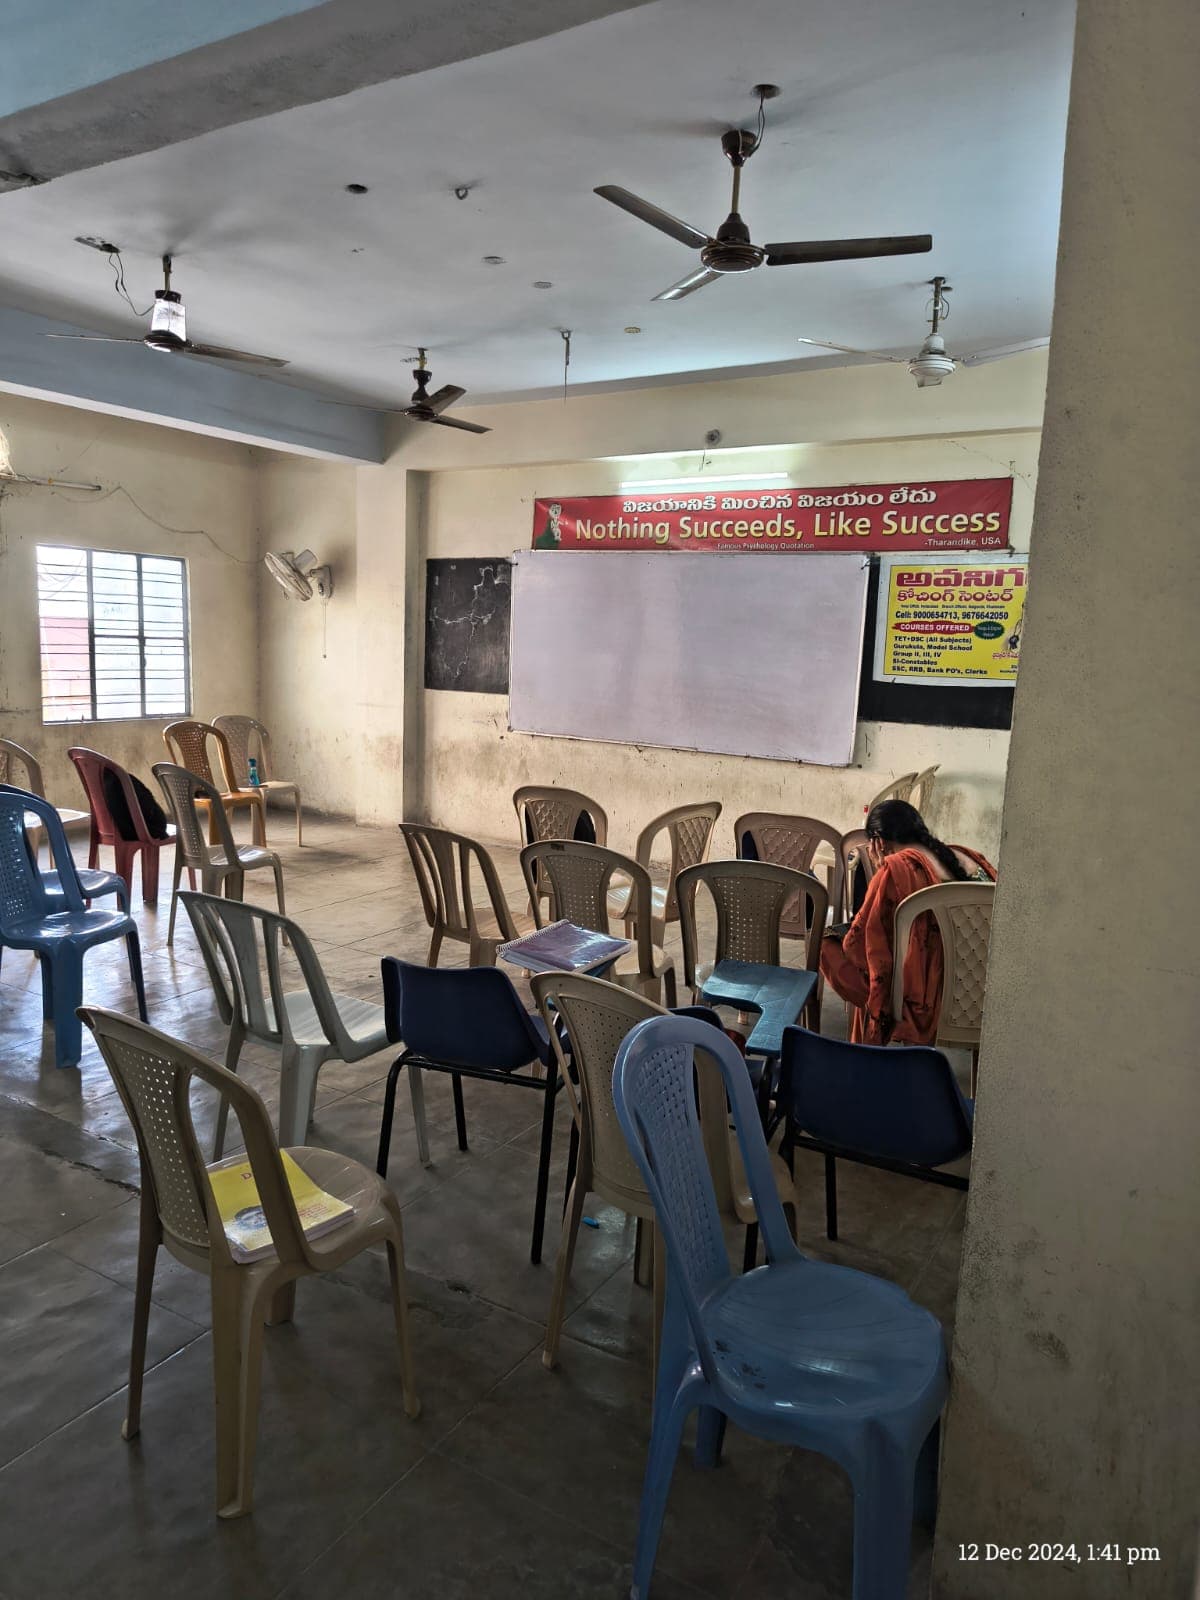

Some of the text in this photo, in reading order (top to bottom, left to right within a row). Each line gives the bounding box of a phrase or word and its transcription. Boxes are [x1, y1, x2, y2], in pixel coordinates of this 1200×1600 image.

[721, 493, 792, 510] మించిన
[797, 490, 884, 508] విజయం
[889, 487, 937, 504] లేదు
[576, 510, 1000, 544] Nothing Succeeds, Like Success
[981, 537, 1001, 545] USA
[743, 542, 778, 551] Psychology
[900, 623, 970, 631] COURSES OFFERED
[939, 636, 972, 644] Subjects)
